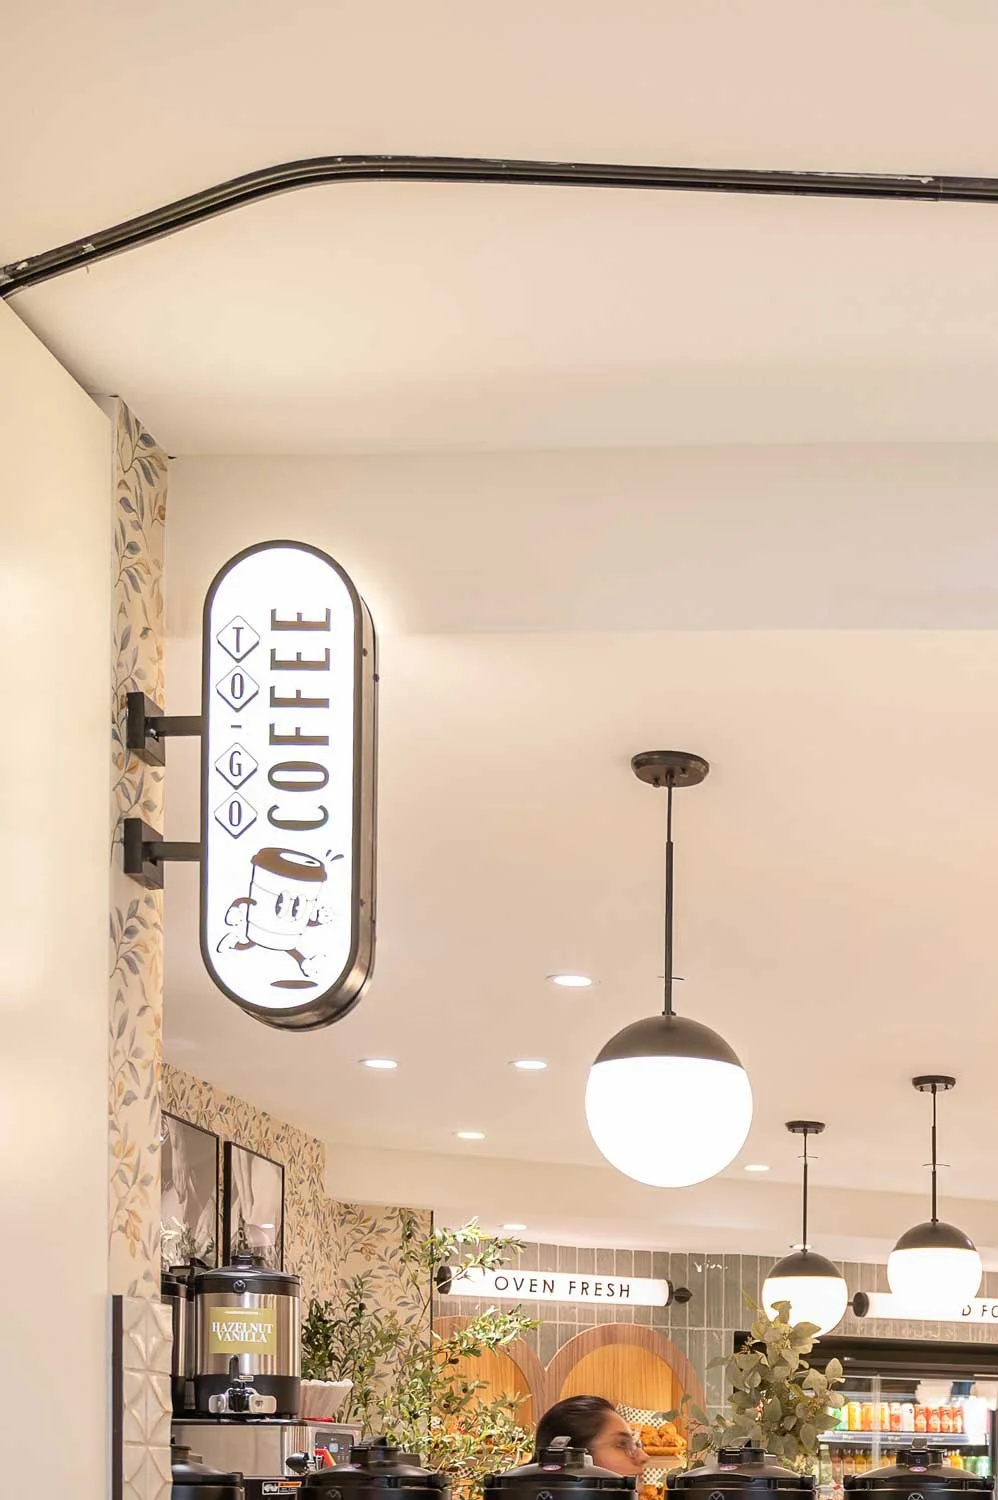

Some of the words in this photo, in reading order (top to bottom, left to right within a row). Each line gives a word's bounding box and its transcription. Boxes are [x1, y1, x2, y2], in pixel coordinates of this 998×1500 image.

[267, 608, 331, 831] COFFEE
[494, 1276, 555, 1294] OVEN
[568, 1280, 630, 1298] FRESH
[212, 1321, 273, 1334] HAZELNUT
[217, 1331, 267, 1343] VANILLA
